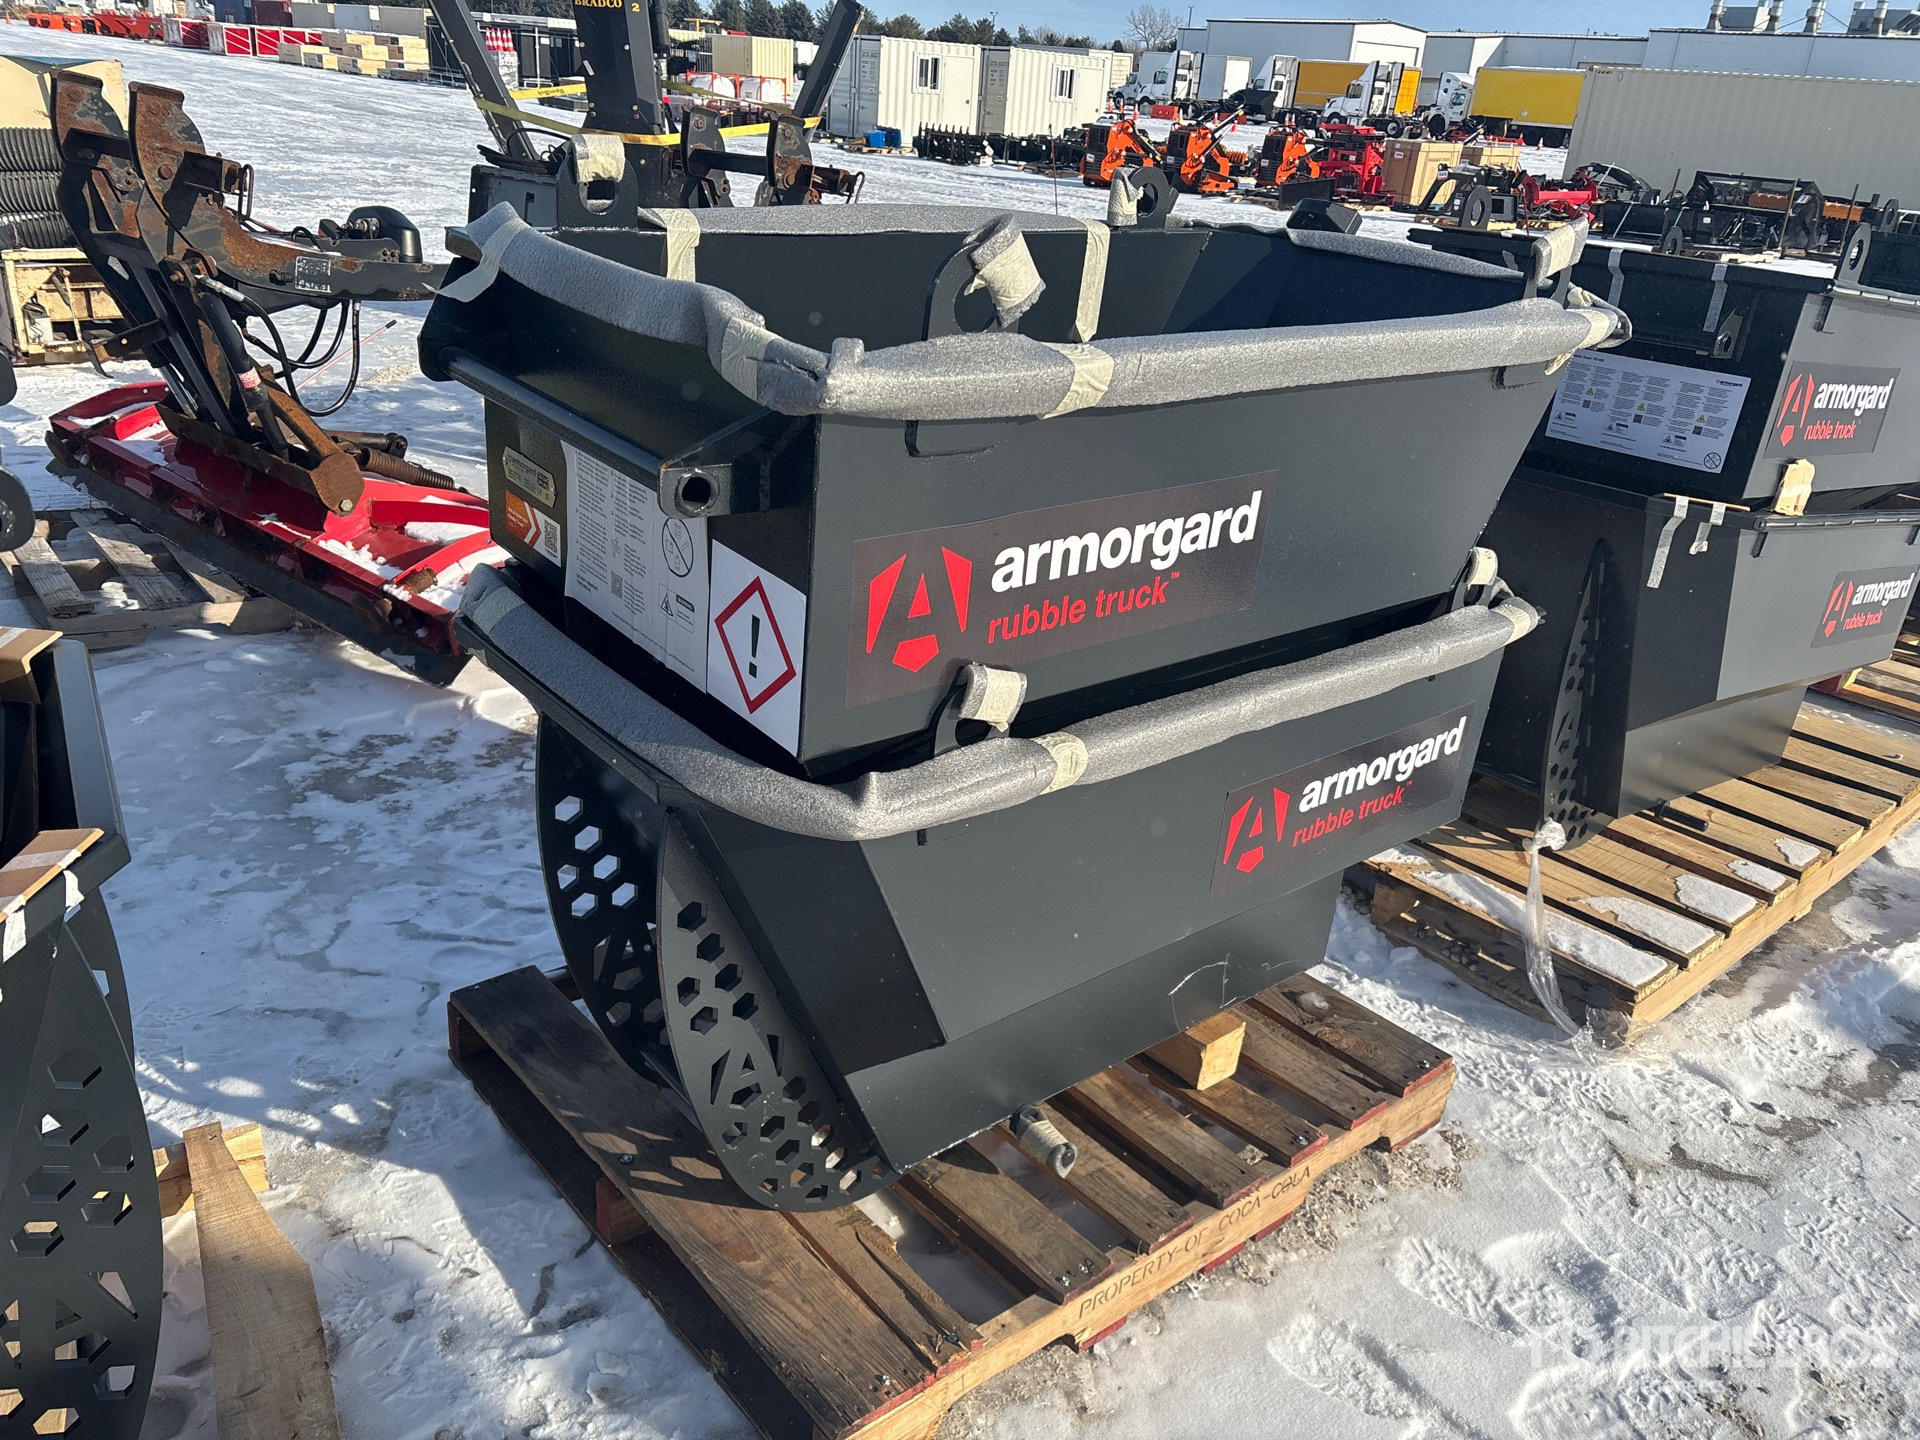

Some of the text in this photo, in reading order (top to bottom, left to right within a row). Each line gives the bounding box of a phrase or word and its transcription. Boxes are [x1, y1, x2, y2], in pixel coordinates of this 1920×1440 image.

[631, 2, 640, 13] 2
[1814, 377, 1895, 417] armorgard
[1804, 420, 1833, 440] rubble
[991, 489, 1263, 594] armorgard
[1851, 572, 1916, 607] armorgard
[987, 597, 1090, 644] rubble
[1298, 715, 1468, 813] armorgard
[1292, 807, 1353, 848] rubble
